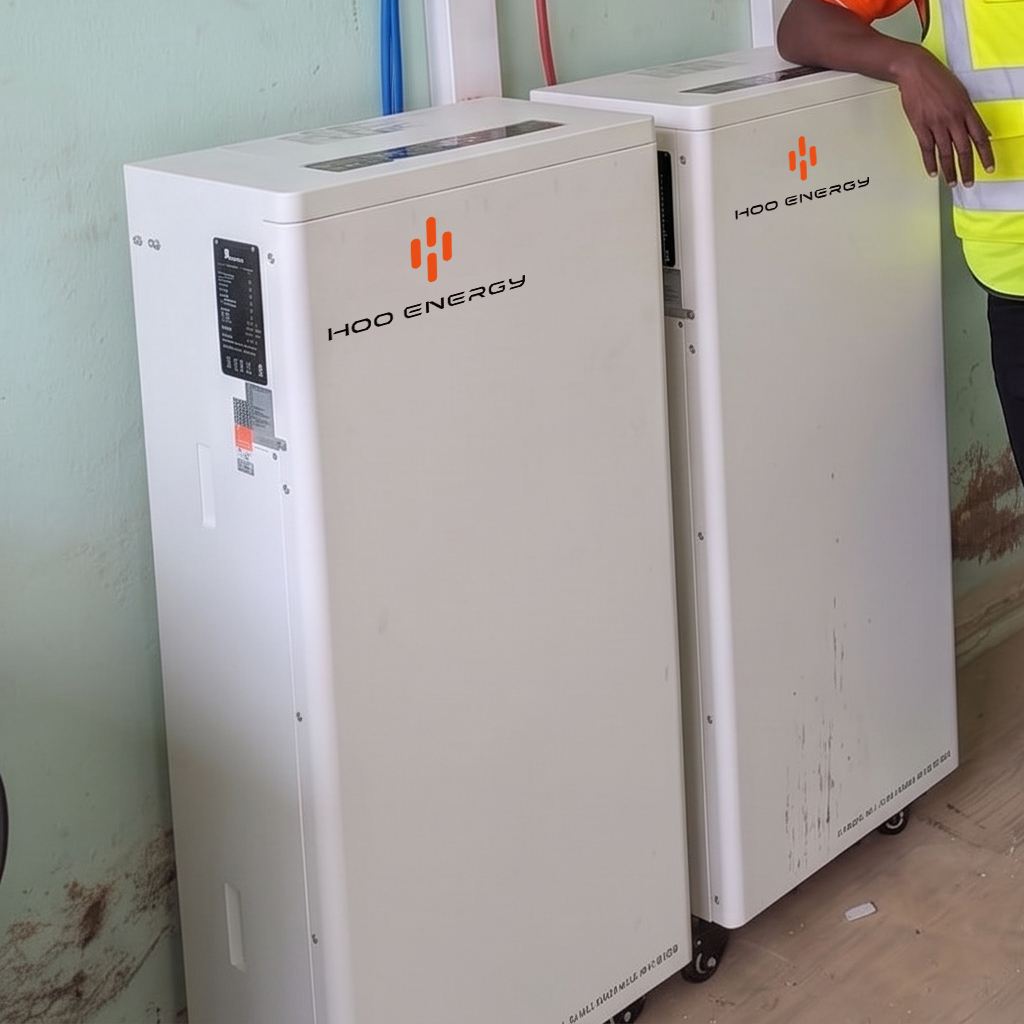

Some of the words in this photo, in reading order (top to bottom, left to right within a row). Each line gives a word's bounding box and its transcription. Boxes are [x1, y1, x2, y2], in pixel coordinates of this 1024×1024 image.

[734, 200, 779, 220] HOO
[784, 176, 870, 207] ENERGY
[327, 311, 394, 341] HOO
[403, 274, 526, 319] ENERGY
